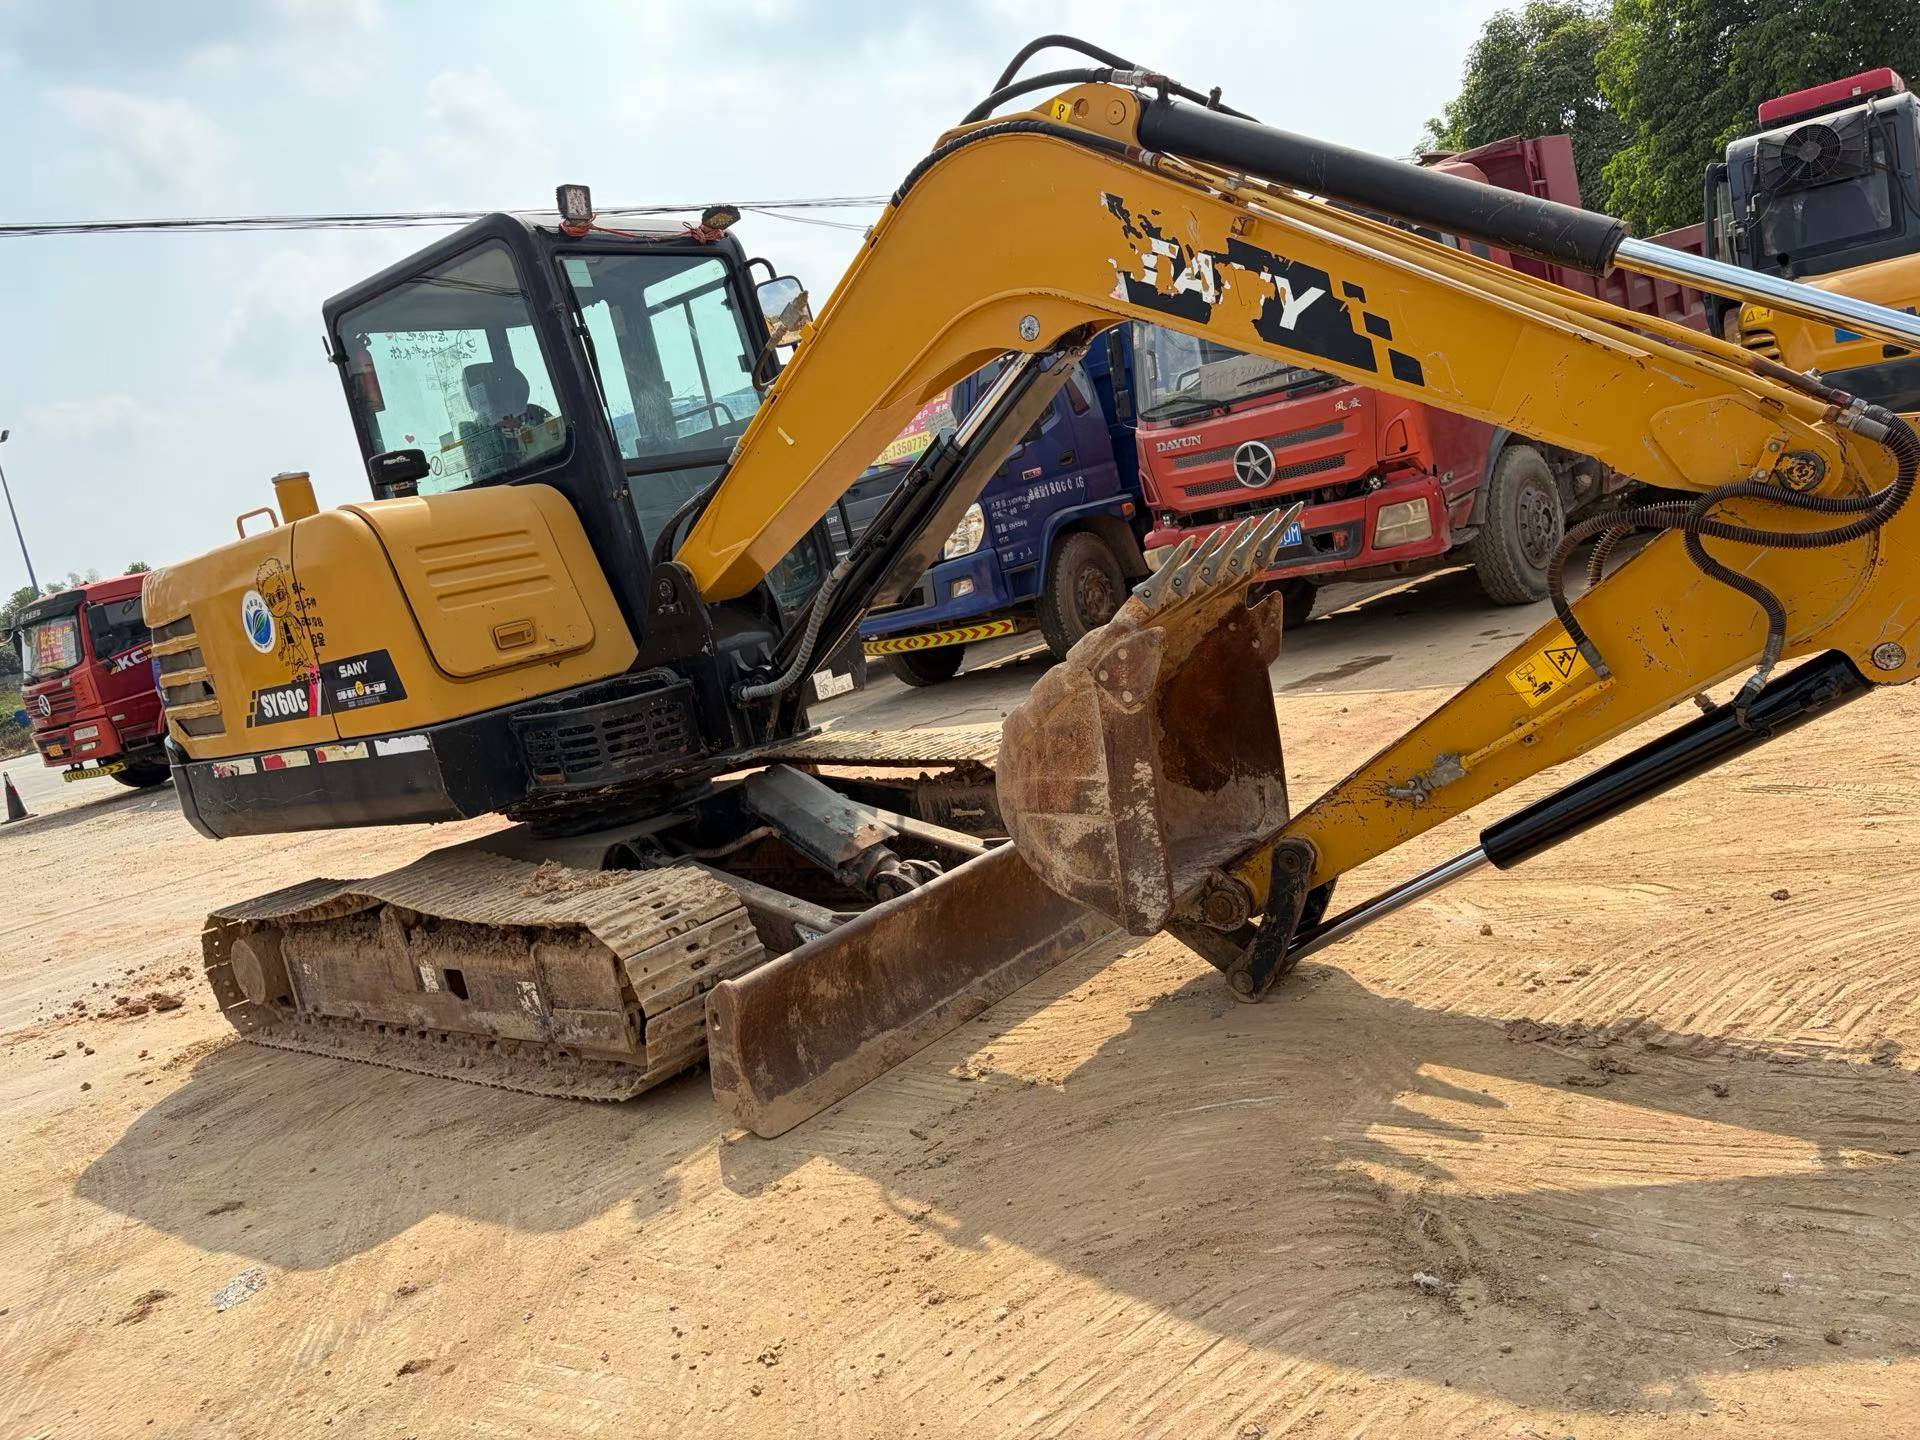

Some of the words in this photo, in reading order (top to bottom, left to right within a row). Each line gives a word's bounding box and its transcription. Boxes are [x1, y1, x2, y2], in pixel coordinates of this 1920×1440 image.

[1155, 434, 1202, 452] DAYUN
[338, 660, 369, 678] SANY
[260, 688, 309, 719] SY60C
